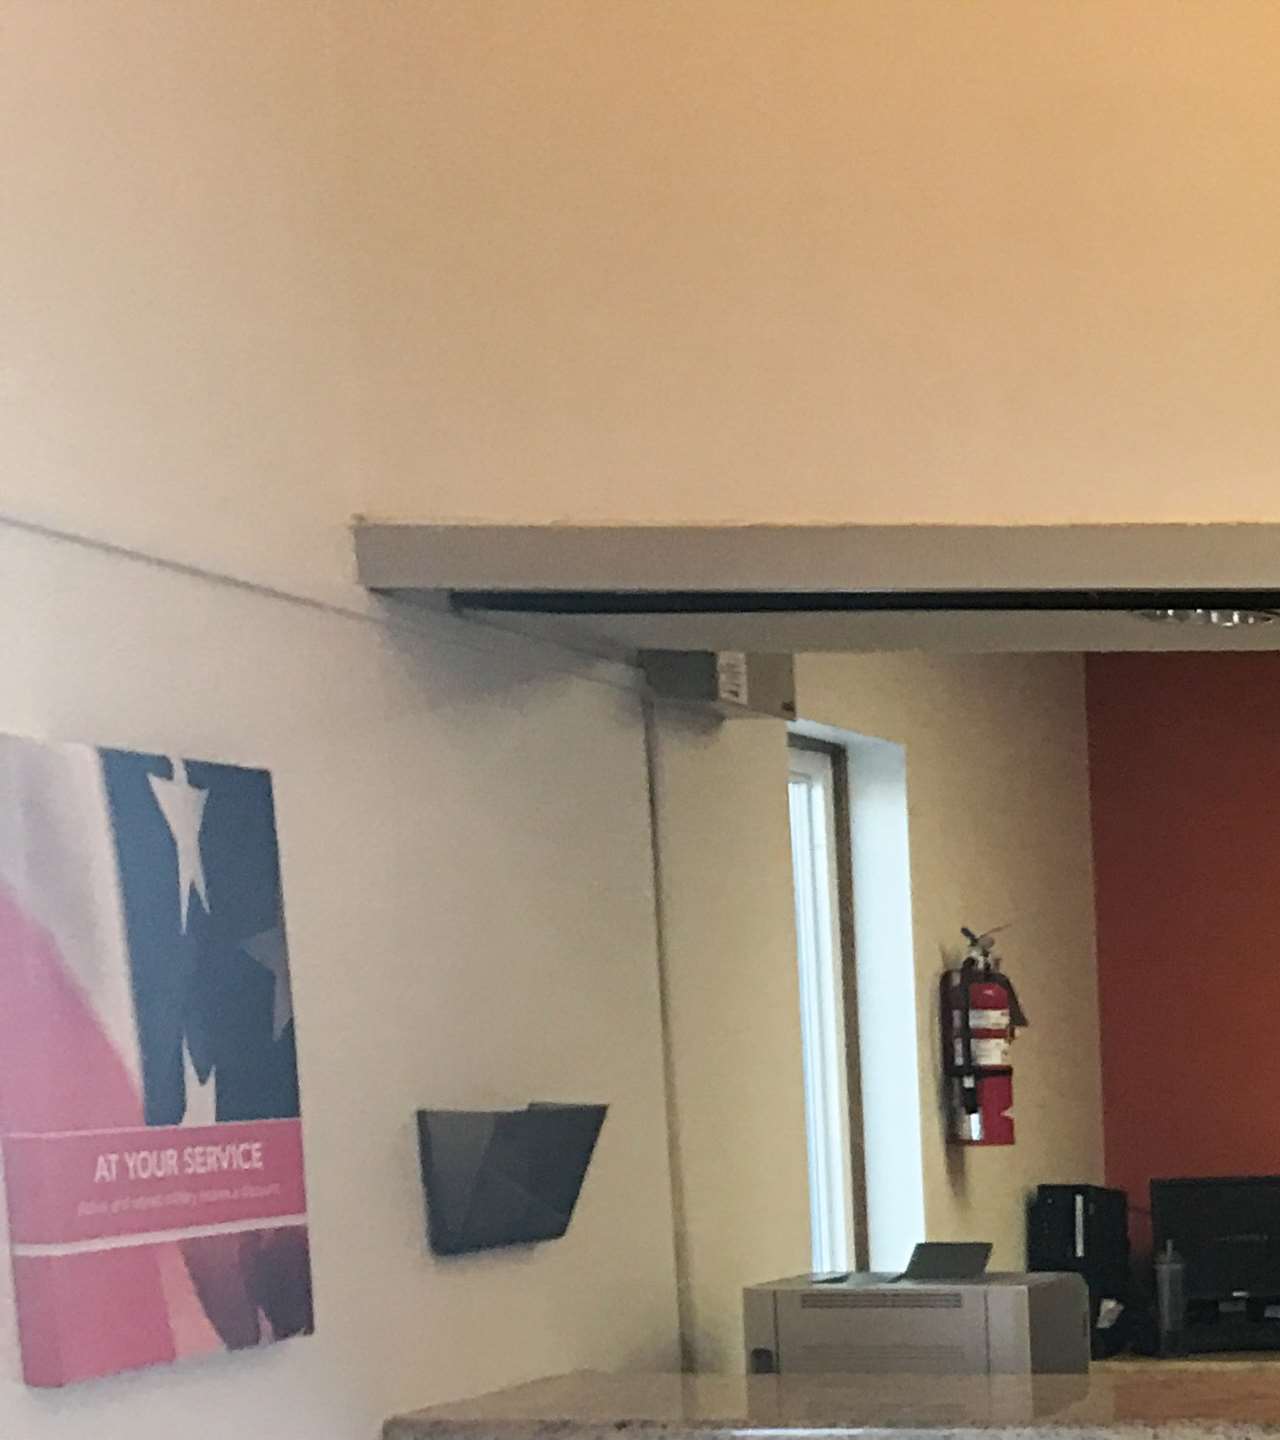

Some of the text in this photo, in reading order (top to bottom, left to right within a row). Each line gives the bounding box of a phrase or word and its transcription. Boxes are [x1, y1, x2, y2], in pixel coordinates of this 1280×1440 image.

[93, 1142, 264, 1184] AT YOUR SERVICE
